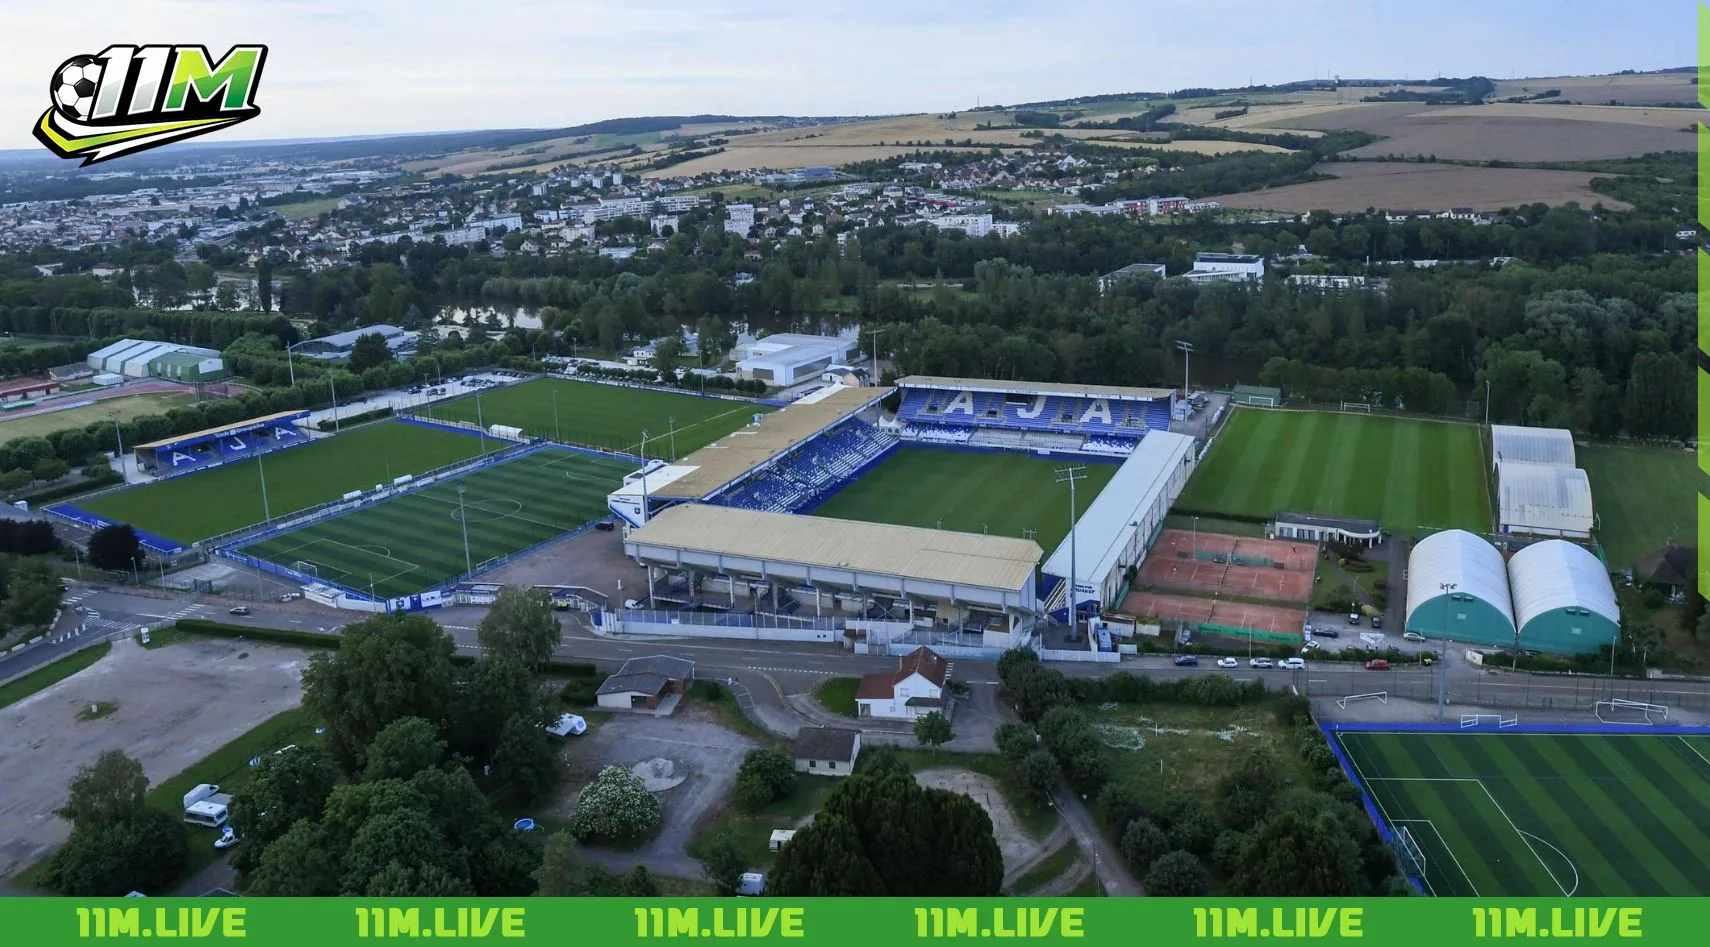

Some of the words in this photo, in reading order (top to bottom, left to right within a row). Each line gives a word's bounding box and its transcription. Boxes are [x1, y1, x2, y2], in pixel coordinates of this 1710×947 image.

[945, 391, 973, 415] A
[1016, 394, 1047, 419] J
[1080, 400, 1112, 424] A
[172, 451, 196, 466] A
[230, 437, 246, 451] J
[275, 427, 296, 440] A
